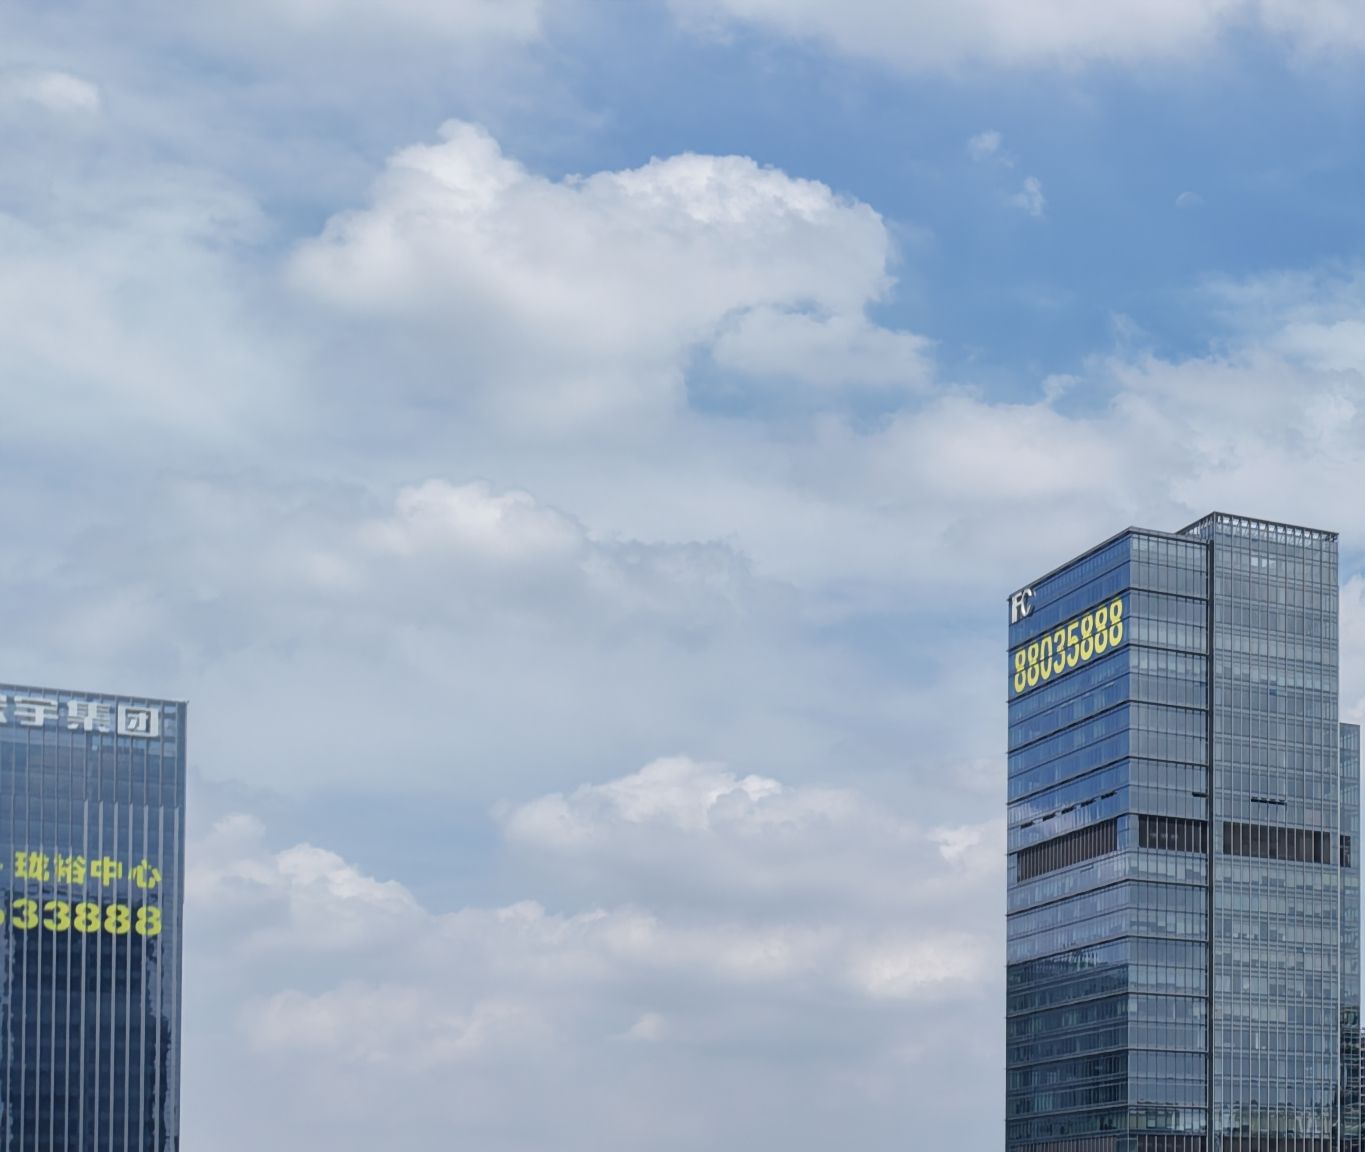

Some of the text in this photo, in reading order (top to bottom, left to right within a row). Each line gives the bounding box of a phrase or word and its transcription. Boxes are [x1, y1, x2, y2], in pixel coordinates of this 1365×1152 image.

[1014, 597, 1123, 693] 88035888
[0, 694, 160, 737] 宇集团
[0, 898, 162, 937] 33888
